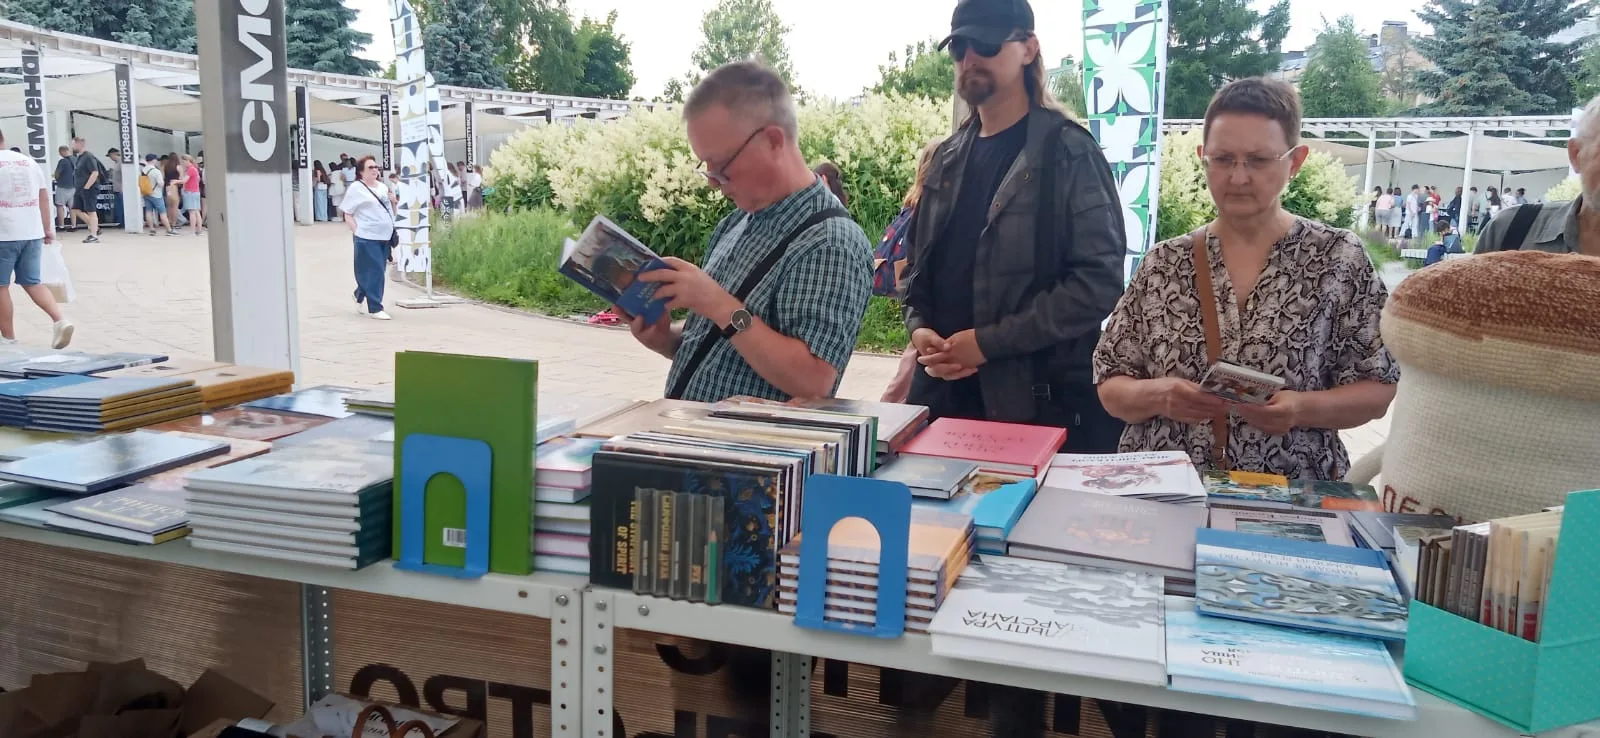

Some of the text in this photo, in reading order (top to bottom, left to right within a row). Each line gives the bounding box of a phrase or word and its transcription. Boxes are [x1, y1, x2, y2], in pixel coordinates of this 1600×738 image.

[118, 79, 133, 162] краеведение
[298, 117, 307, 167] проза
[616, 526, 628, 574] OF SPIRIT
